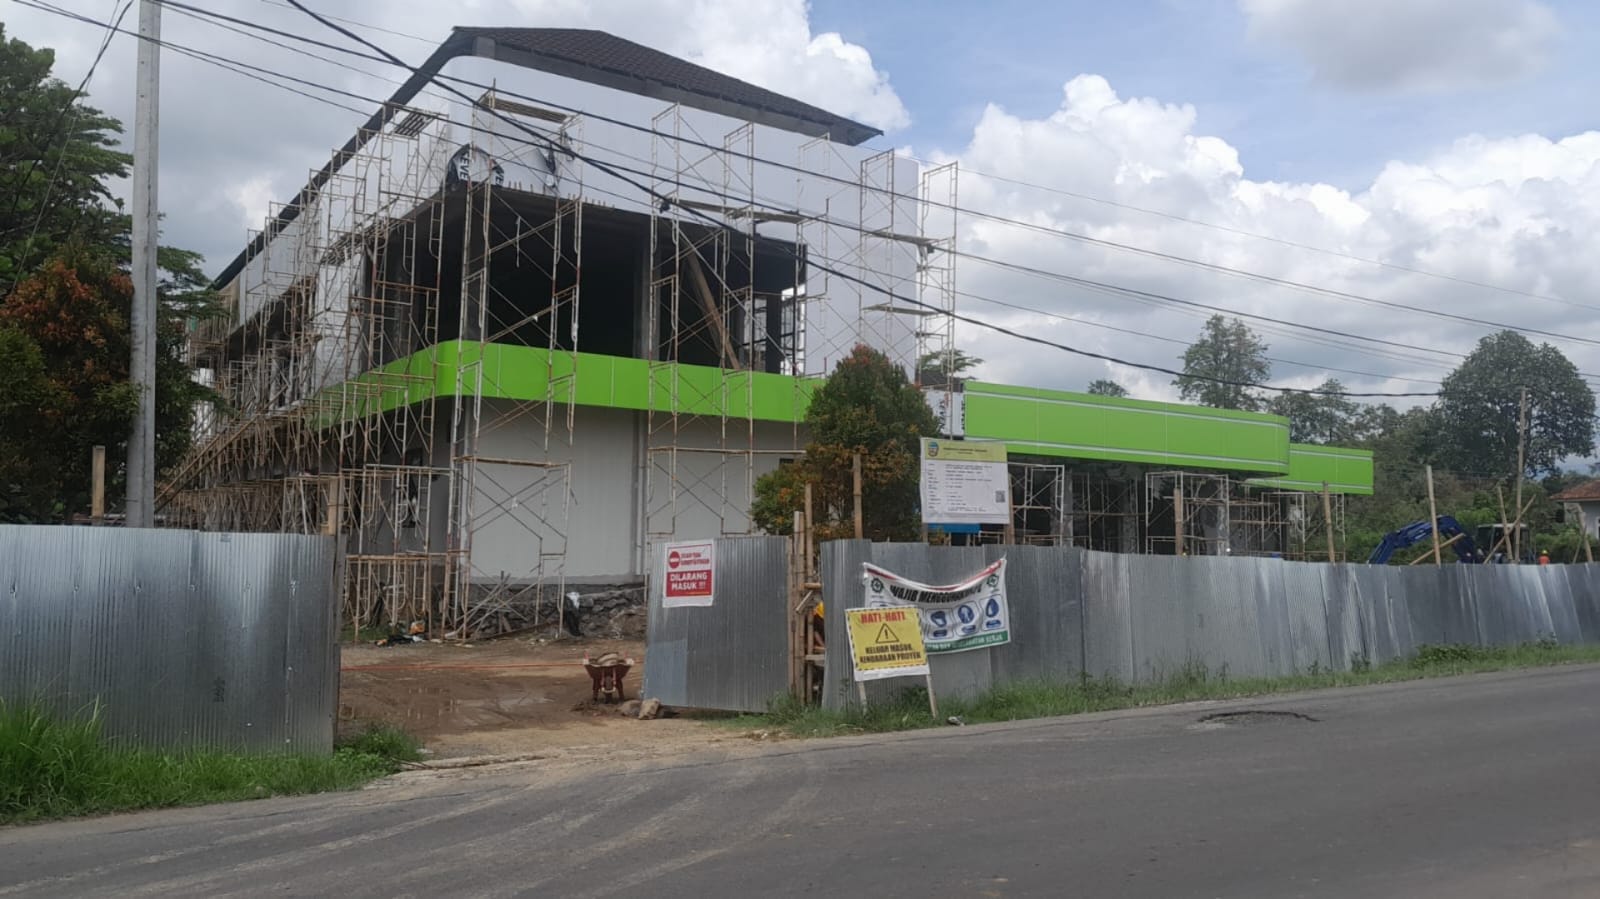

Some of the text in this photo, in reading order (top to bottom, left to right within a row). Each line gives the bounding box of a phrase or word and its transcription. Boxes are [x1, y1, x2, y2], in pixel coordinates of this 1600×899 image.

[670, 572, 707, 581] DILARANG
[672, 581, 697, 590] MASUK
[890, 585, 918, 602] WAJIB
[861, 611, 905, 624] HATI-HATI
[865, 643, 913, 654] KELUAR MASUK
[860, 653, 896, 663] KENDARAAN
[896, 651, 921, 661] PROYEK
